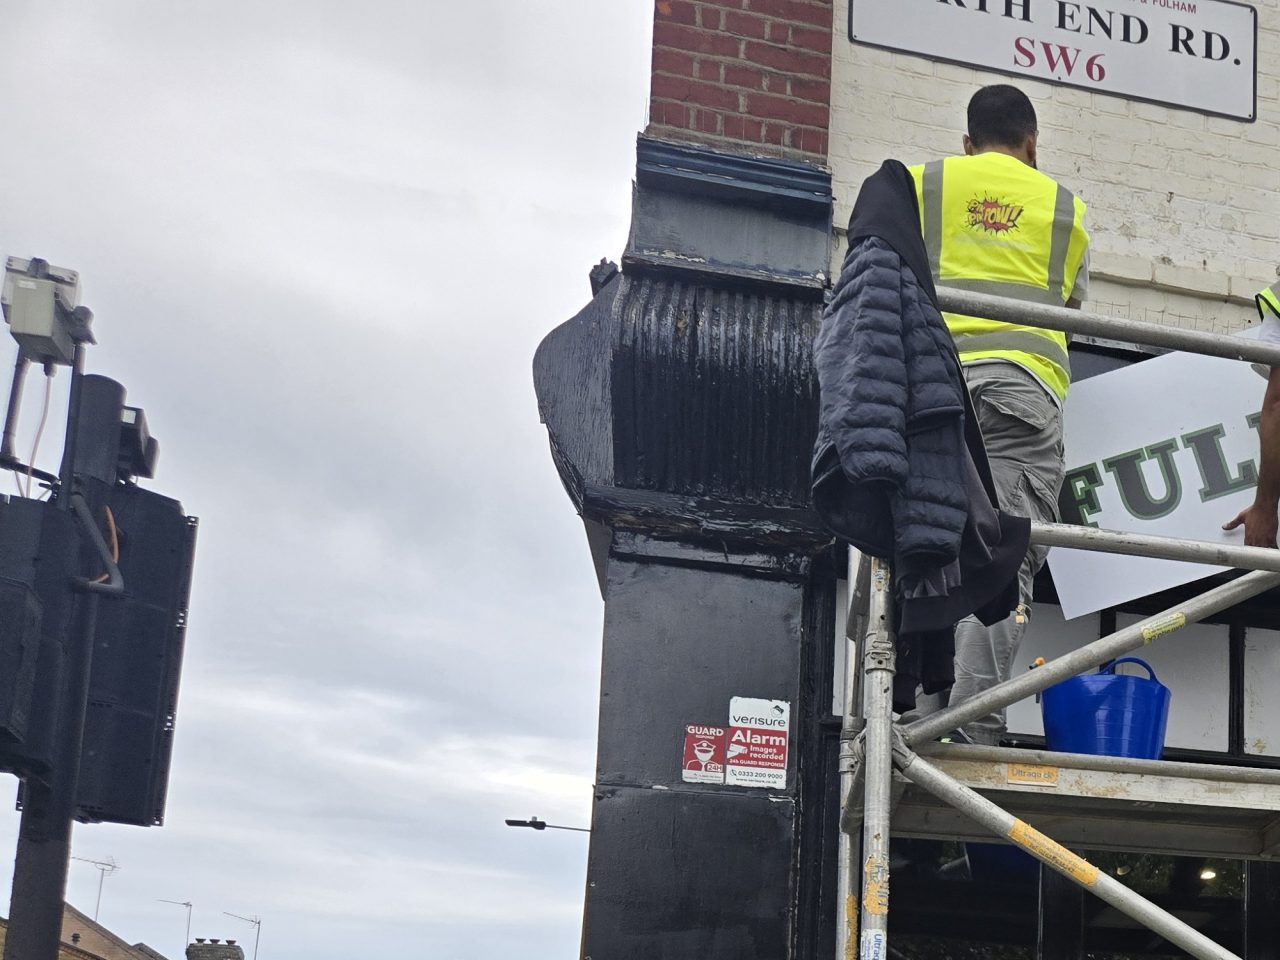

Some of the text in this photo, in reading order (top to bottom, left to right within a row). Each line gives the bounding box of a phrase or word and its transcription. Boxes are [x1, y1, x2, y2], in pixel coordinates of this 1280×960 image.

[1055, 1, 1148, 44] END
[1168, 23, 1240, 65] RD.
[1014, 37, 1106, 81] SW6
[732, 715, 786, 728] verisure
[687, 725, 724, 736] GUARD
[731, 730, 786, 746] Alarm
[750, 745, 777, 754] Images
[750, 752, 784, 761] recorded
